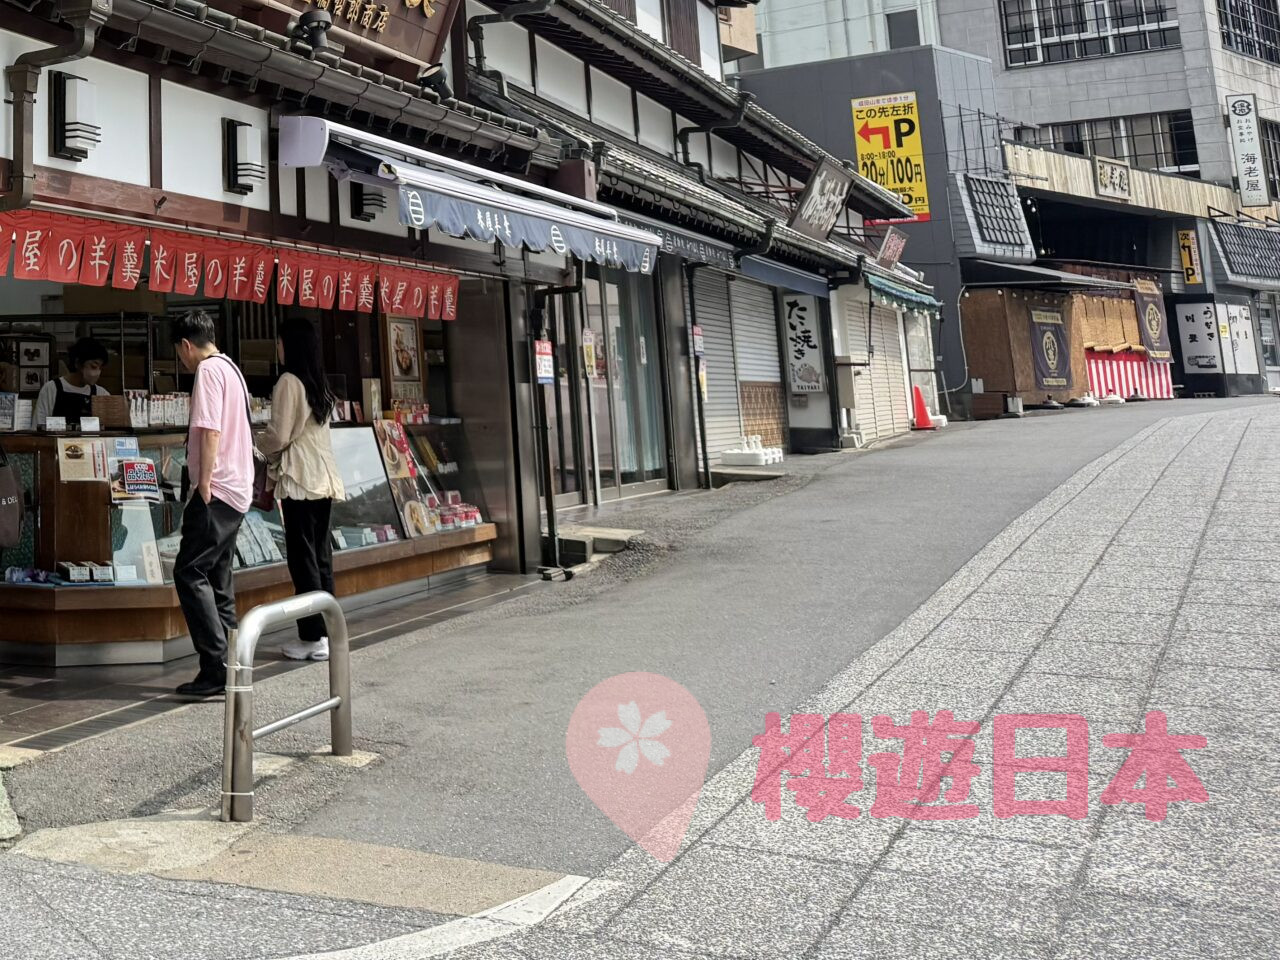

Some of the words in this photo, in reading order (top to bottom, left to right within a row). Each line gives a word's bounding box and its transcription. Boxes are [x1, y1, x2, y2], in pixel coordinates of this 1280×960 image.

[856, 103, 914, 120] この先左折
[894, 118, 915, 148] P
[1241, 153, 1262, 192] 海老屋
[1180, 232, 1190, 241] 次
[1185, 267, 1196, 282] P
[786, 299, 818, 360] たい焼き
